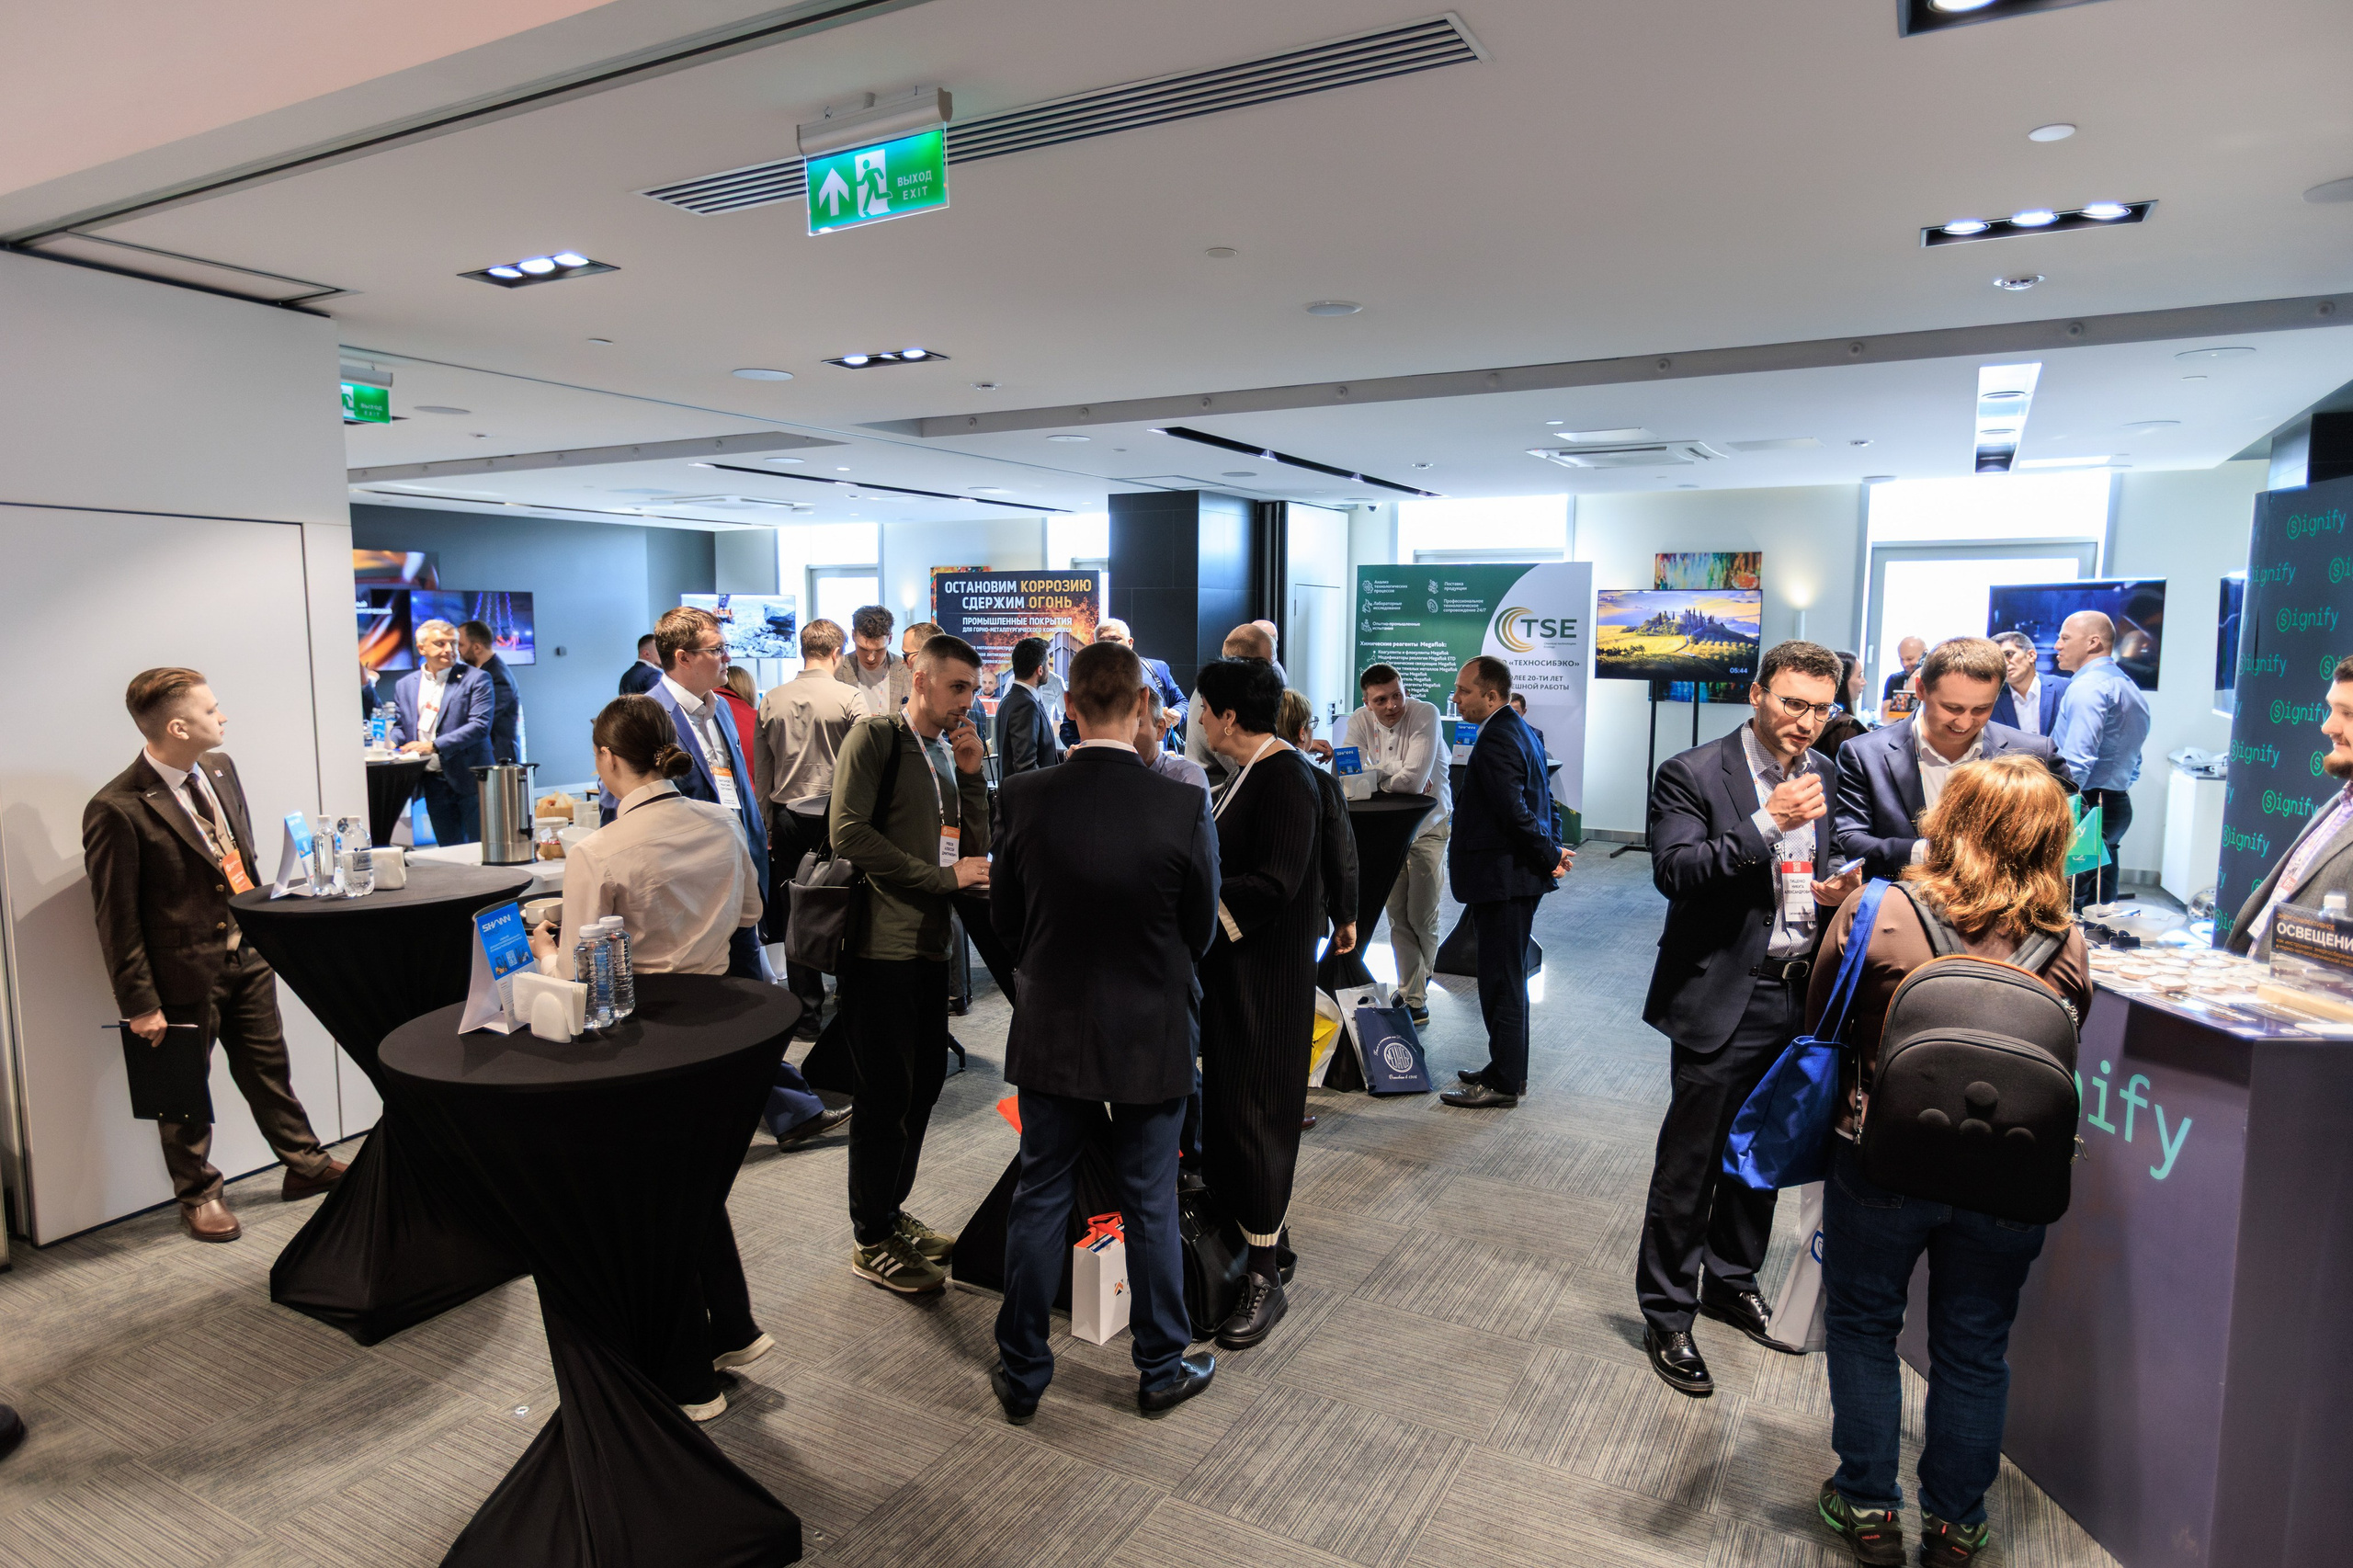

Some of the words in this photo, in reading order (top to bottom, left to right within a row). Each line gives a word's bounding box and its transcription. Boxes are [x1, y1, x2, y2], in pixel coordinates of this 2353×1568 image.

[897, 170, 932, 187] ВЫХОД
[903, 186, 928, 200] EXIT
[945, 580, 1017, 594] ОСТАНОВИМ
[1020, 579, 1092, 593] КОРРОЗИЮ
[962, 597, 1025, 610] СДЕРЖИМ
[1029, 596, 1073, 609] ОГОНЬ
[962, 617, 1028, 626] ПРОМЫШЛЕННЫЕ
[1029, 617, 1073, 626] ПОКРЫТИЯ
[1520, 619, 1577, 638] TSE
